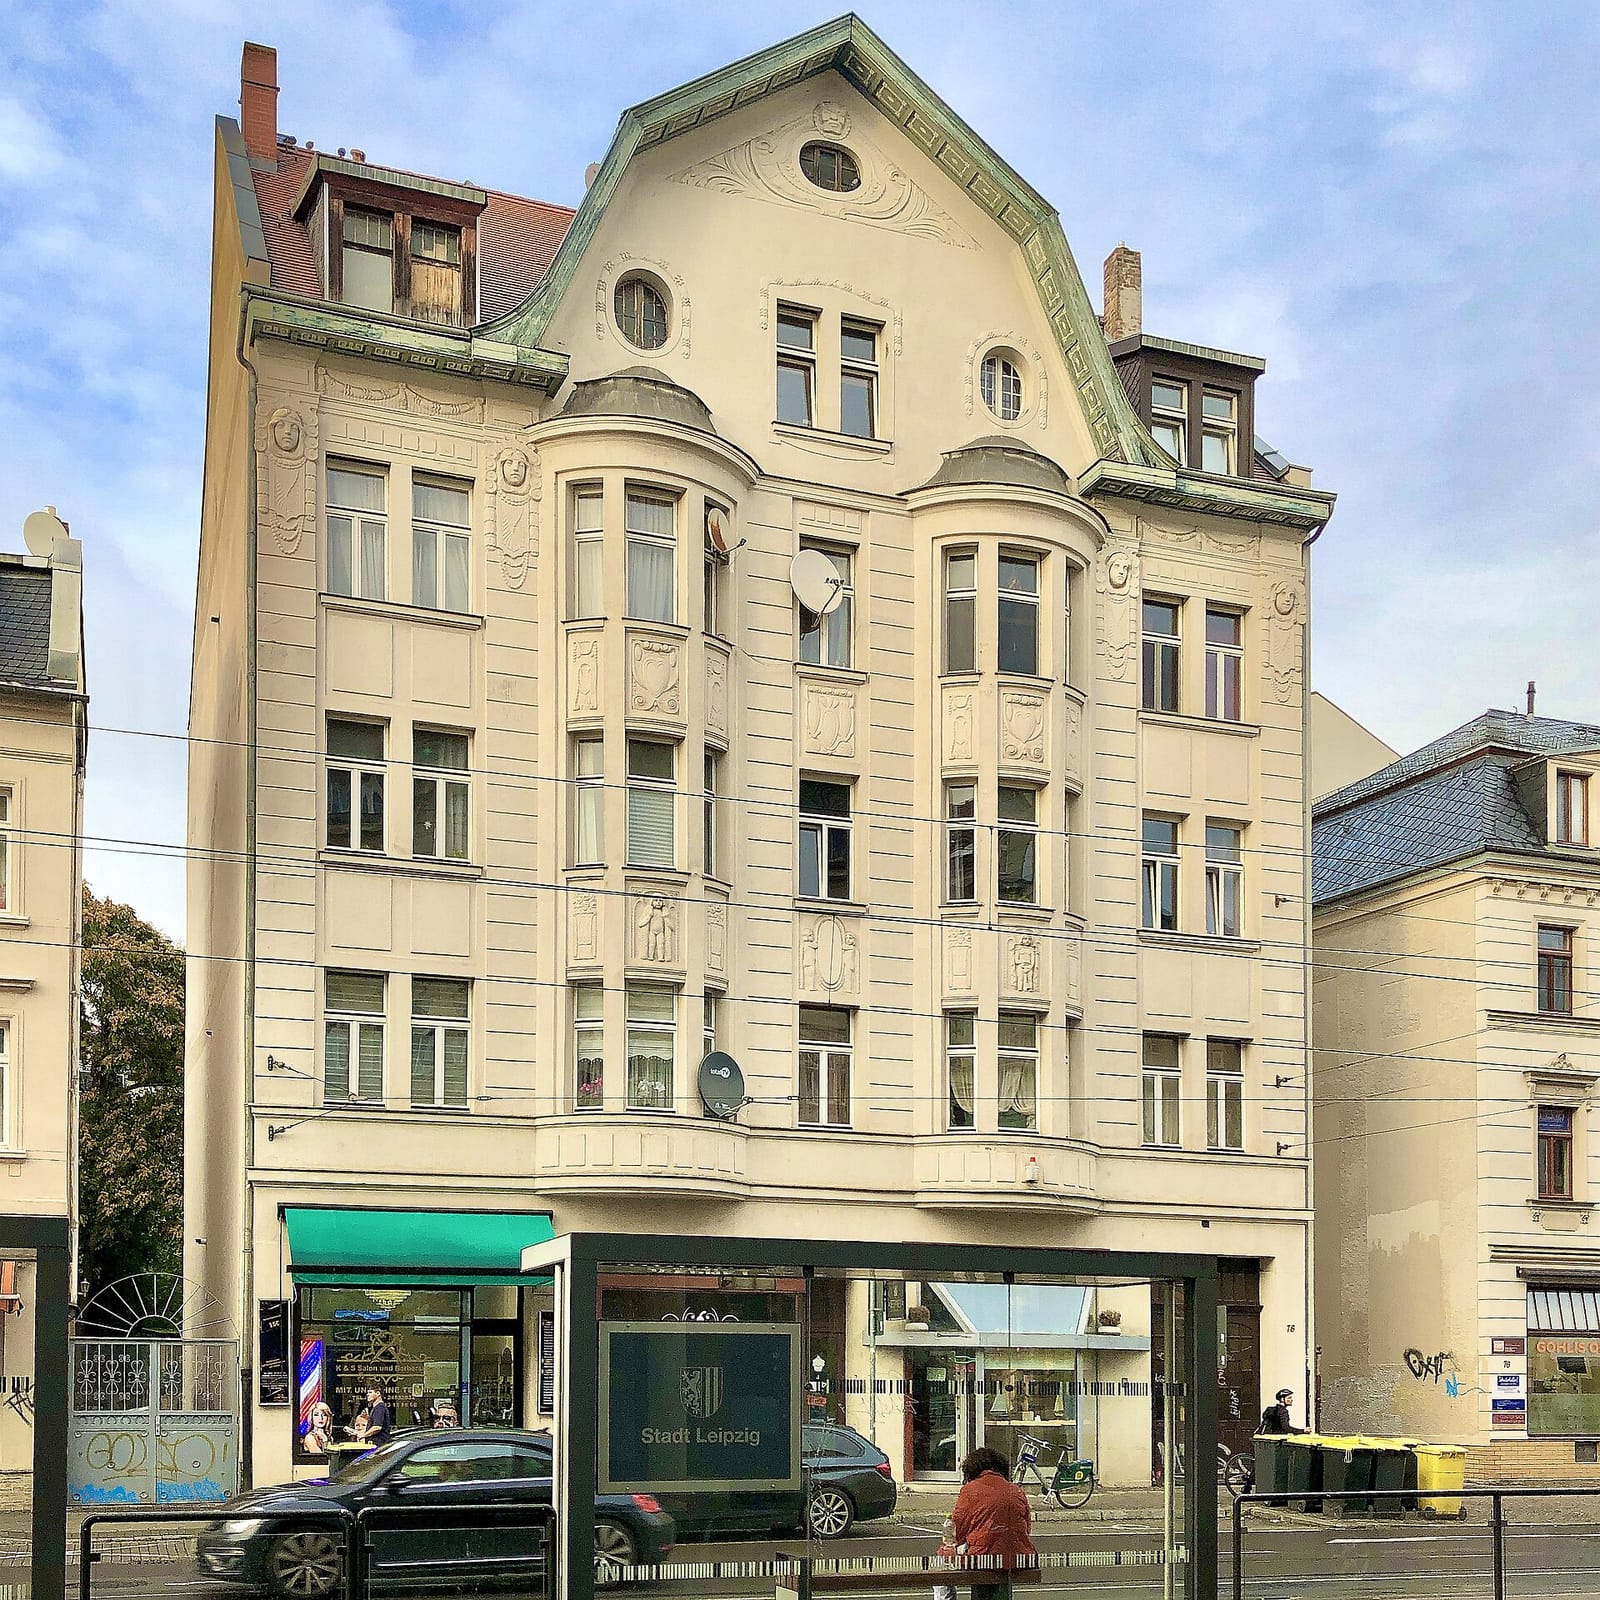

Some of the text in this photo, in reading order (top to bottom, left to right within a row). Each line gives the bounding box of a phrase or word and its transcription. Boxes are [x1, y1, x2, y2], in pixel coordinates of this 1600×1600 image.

[1536, 1341, 1585, 1354] GOHLIS
[335, 1364, 342, 1372] K
[343, 1364, 349, 1372] &
[350, 1364, 356, 1372] S
[357, 1364, 378, 1372] Salon
[380, 1364, 393, 1372] und
[335, 1386, 352, 1394] MIT
[354, 1386, 367, 1394] UN
[641, 1427, 760, 1447] Stadt Leipzig
